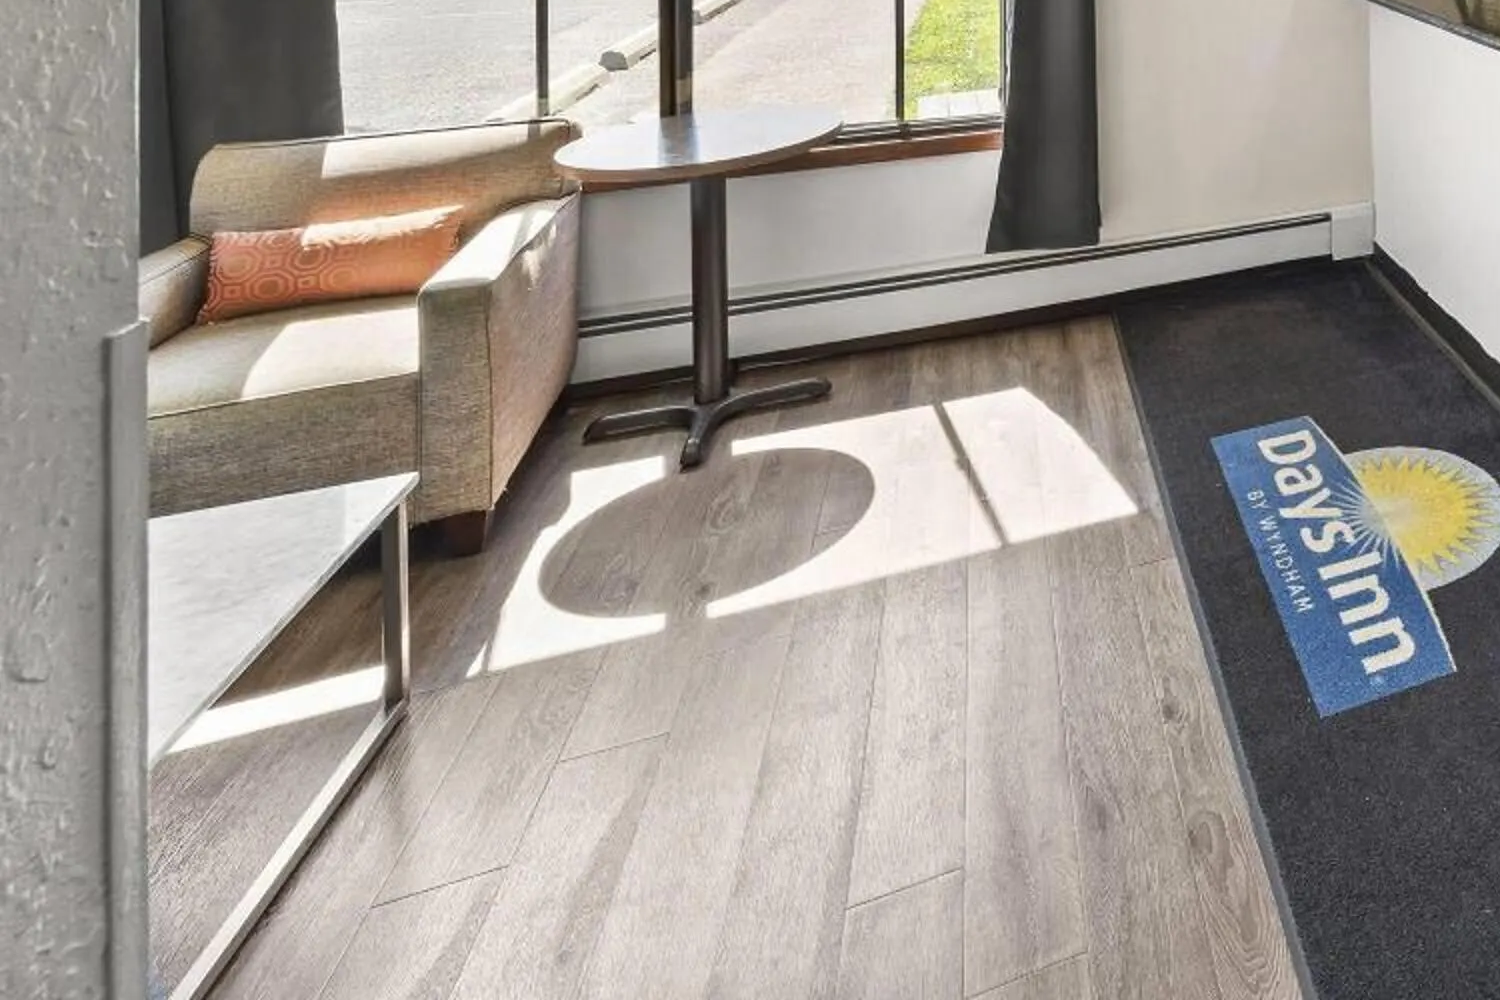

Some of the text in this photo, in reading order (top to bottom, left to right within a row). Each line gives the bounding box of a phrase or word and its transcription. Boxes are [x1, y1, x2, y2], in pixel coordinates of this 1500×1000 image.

[1247, 489, 1315, 613] BY WYNDHAM
[1257, 429, 1416, 676] Days Inn
